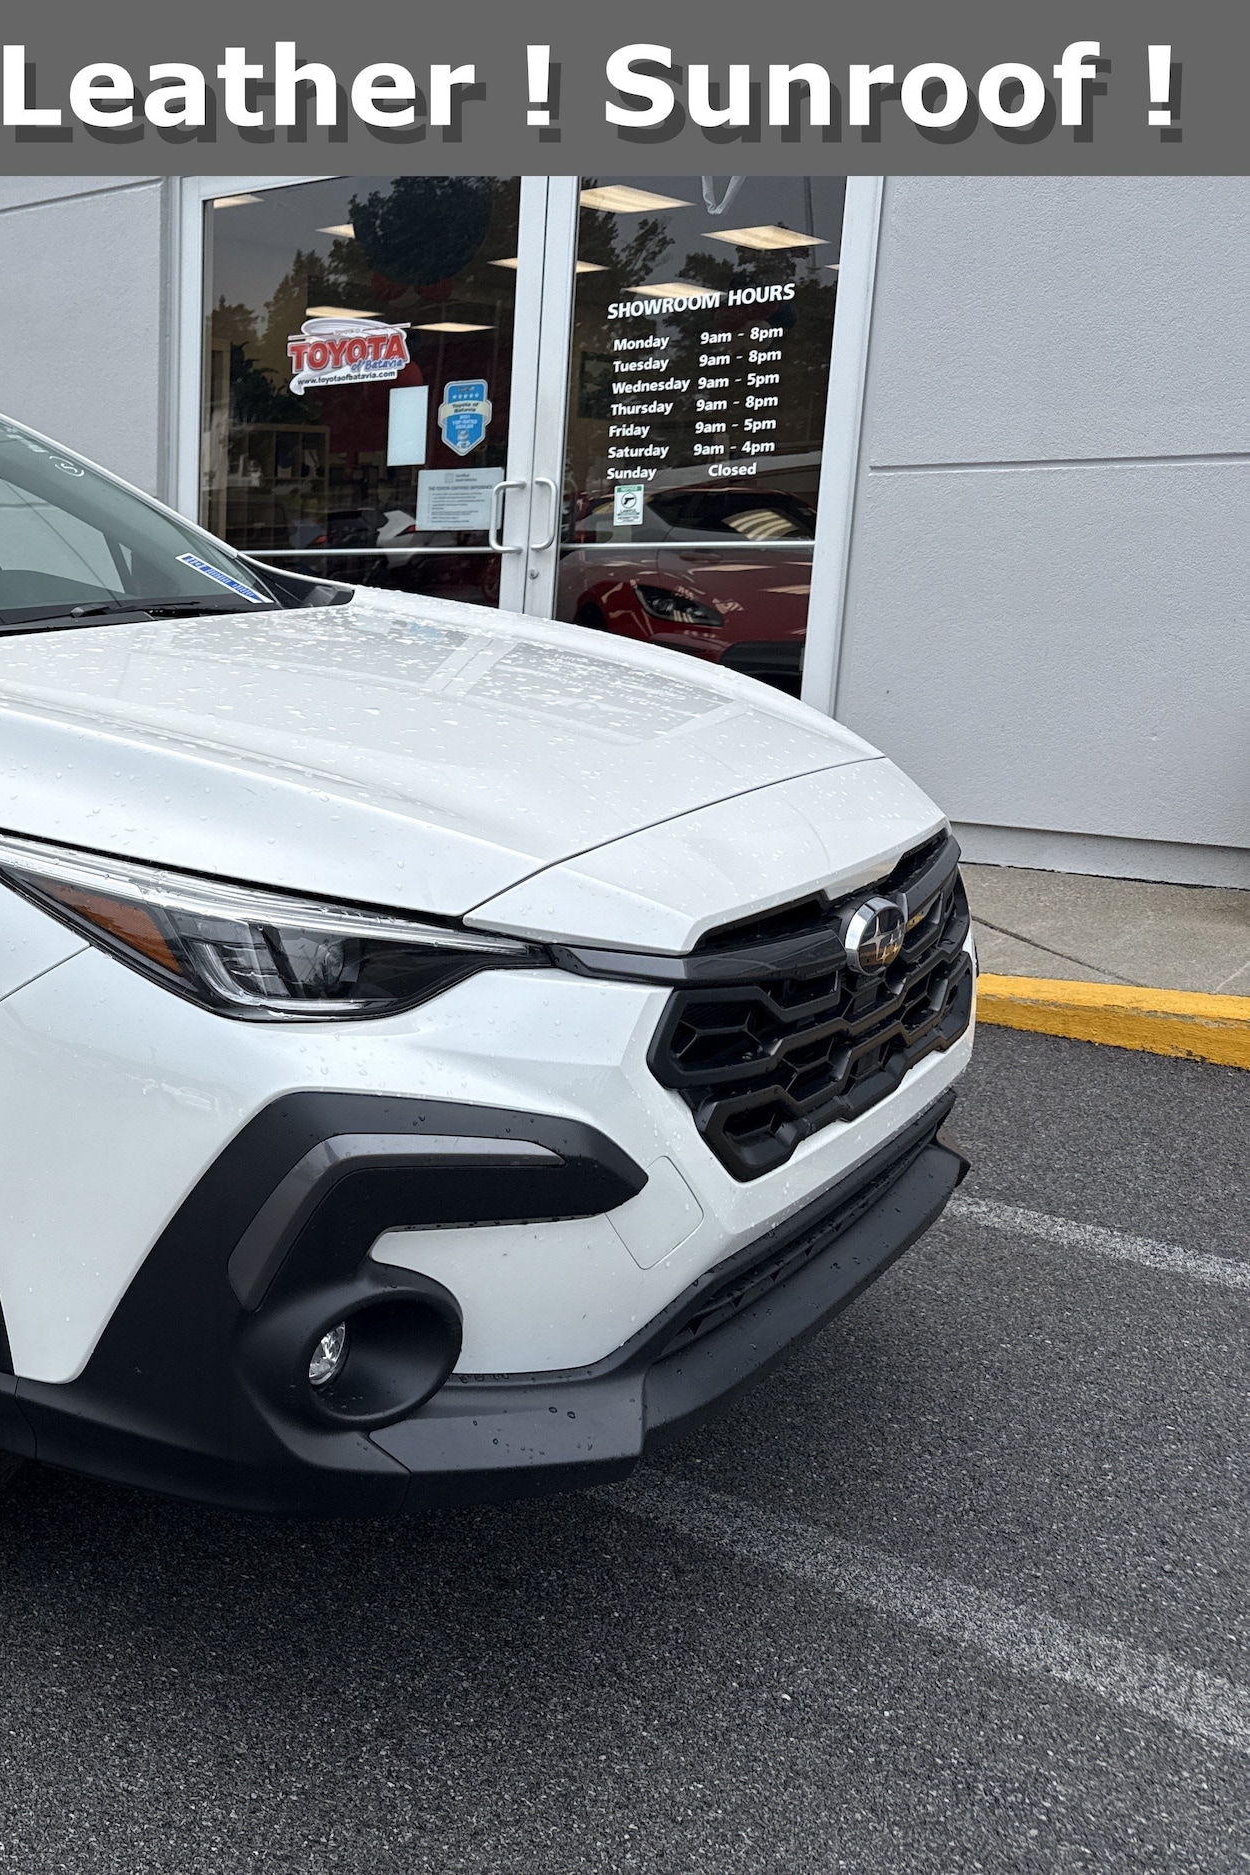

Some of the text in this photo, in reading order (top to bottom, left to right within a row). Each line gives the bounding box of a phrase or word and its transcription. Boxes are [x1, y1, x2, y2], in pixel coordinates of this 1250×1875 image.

[607, 283, 795, 320] SHOWROOM HOURS
[613, 335, 670, 351] Monday
[700, 331, 732, 345] 9am
[750, 326, 784, 342] 8pm
[290, 334, 406, 370] TOYOTA
[612, 357, 670, 373] Tuesday
[699, 354, 731, 367] 9am
[748, 349, 782, 365] 8pm
[365, 357, 403, 371] Batavia
[297, 371, 396, 385] www.toyotaofbatavia.com
[612, 377, 691, 395] Wednesday
[698, 376, 729, 390] 9am
[747, 372, 780, 388] 5pm
[610, 400, 674, 416] Thursday
[696, 399, 728, 412] 9am
[745, 395, 779, 411] 8pm
[608, 423, 650, 439] Friday
[695, 421, 726, 434] 9am
[744, 418, 777, 433] 5pm
[607, 443, 670, 459] Saturday
[693, 443, 725, 456] 9am
[741, 440, 775, 456] 4pm
[606, 462, 757, 481] Sunday Closed
